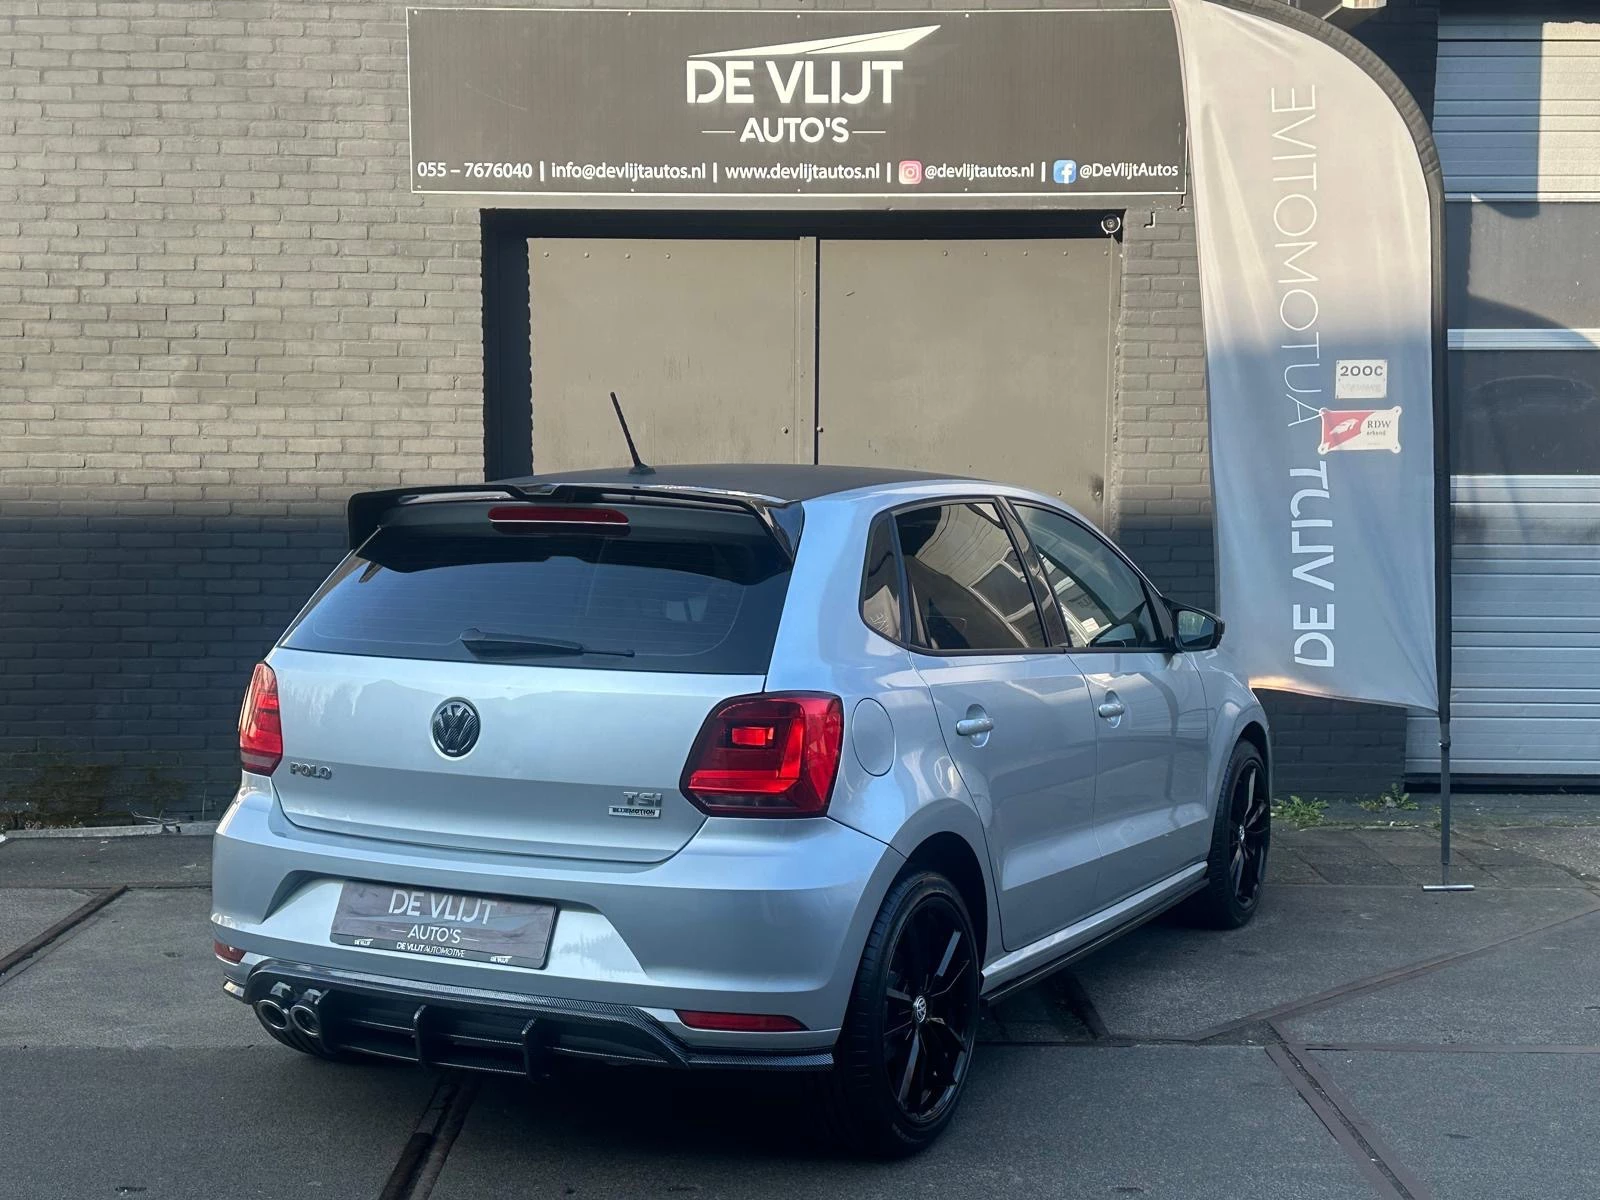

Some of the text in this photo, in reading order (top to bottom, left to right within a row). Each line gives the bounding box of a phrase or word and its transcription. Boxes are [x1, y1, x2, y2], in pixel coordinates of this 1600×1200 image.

[686, 60, 904, 105] DE VLIJT
[739, 116, 850, 143] AUTO'S
[417, 161, 447, 178] 055
[463, 161, 533, 179] 7676040
[551, 161, 706, 182] info@devlijtautos.nl
[724, 162, 880, 182] www.devlijtautos.nl
[924, 162, 1035, 181] @devlijtautos.nl
[1079, 161, 1179, 180] @DeVlijtAutos
[1367, 420, 1391, 428] RDW
[289, 761, 333, 780] POLO
[623, 791, 662, 807] TSI
[388, 889, 498, 925] DE VLIJT
[407, 924, 462, 944] AUTO'S
[396, 941, 406, 950] DE
